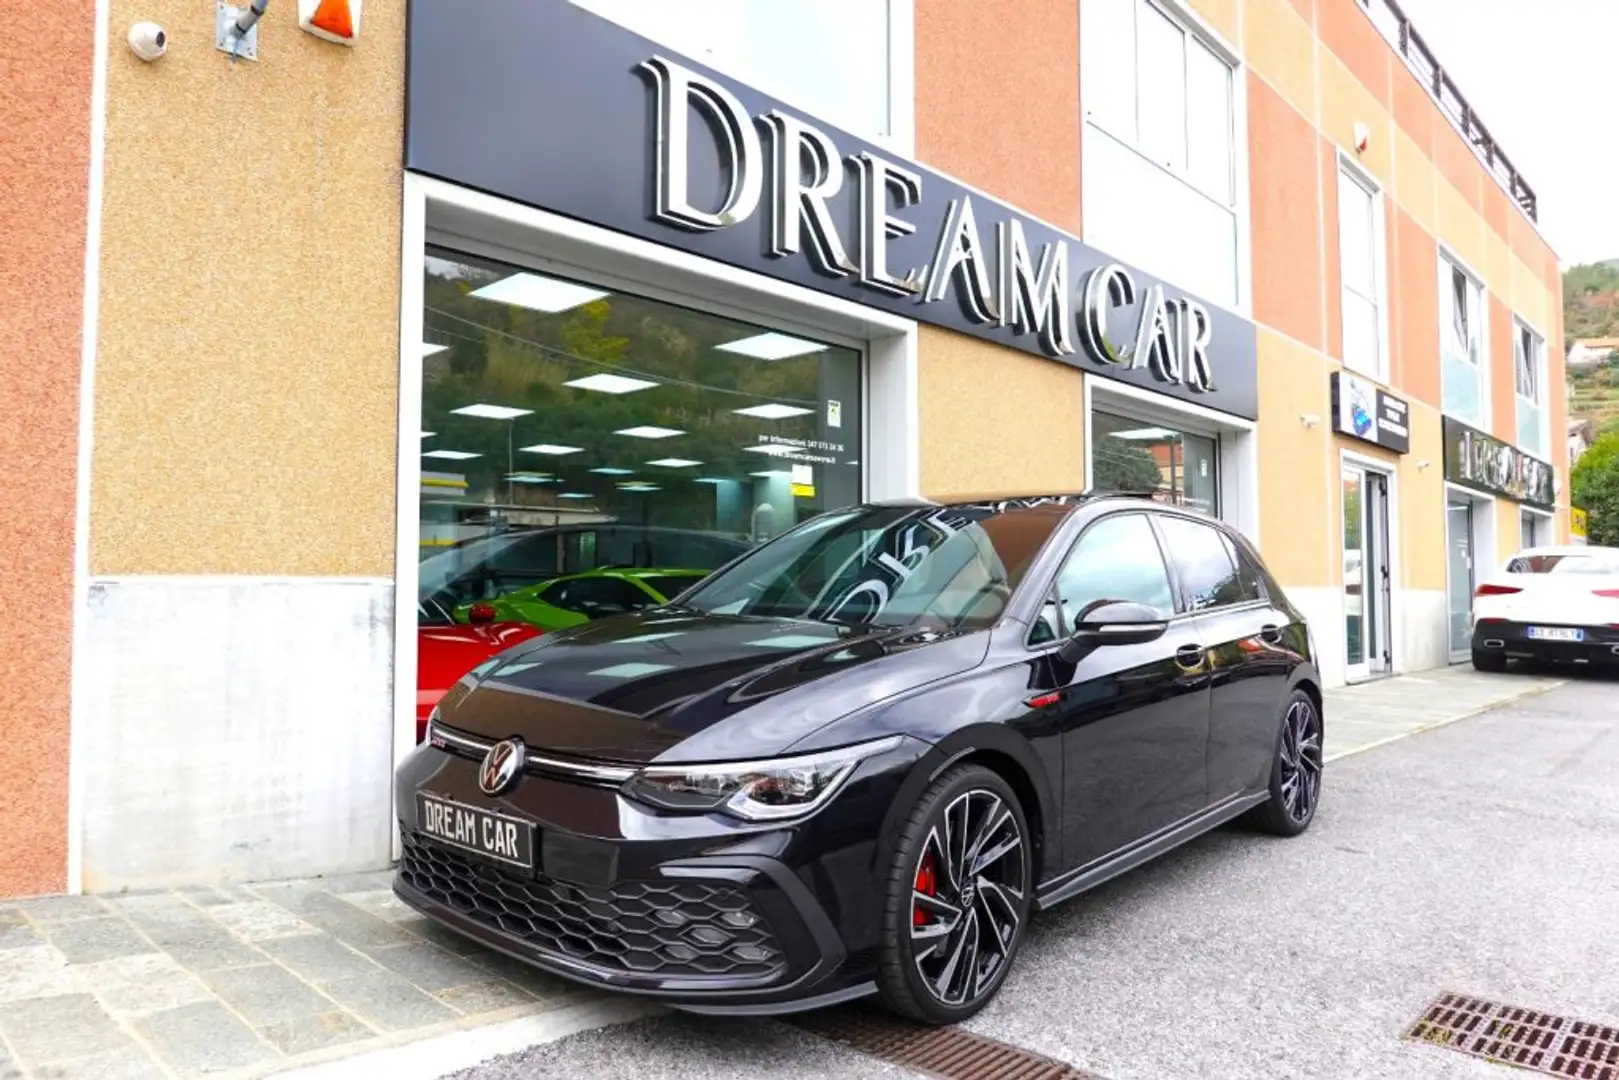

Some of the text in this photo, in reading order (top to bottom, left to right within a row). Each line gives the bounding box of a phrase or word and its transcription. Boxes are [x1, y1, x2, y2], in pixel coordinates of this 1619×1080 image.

[633, 54, 1219, 393] DREAM CAR
[424, 800, 518, 858] DREAM CAR
